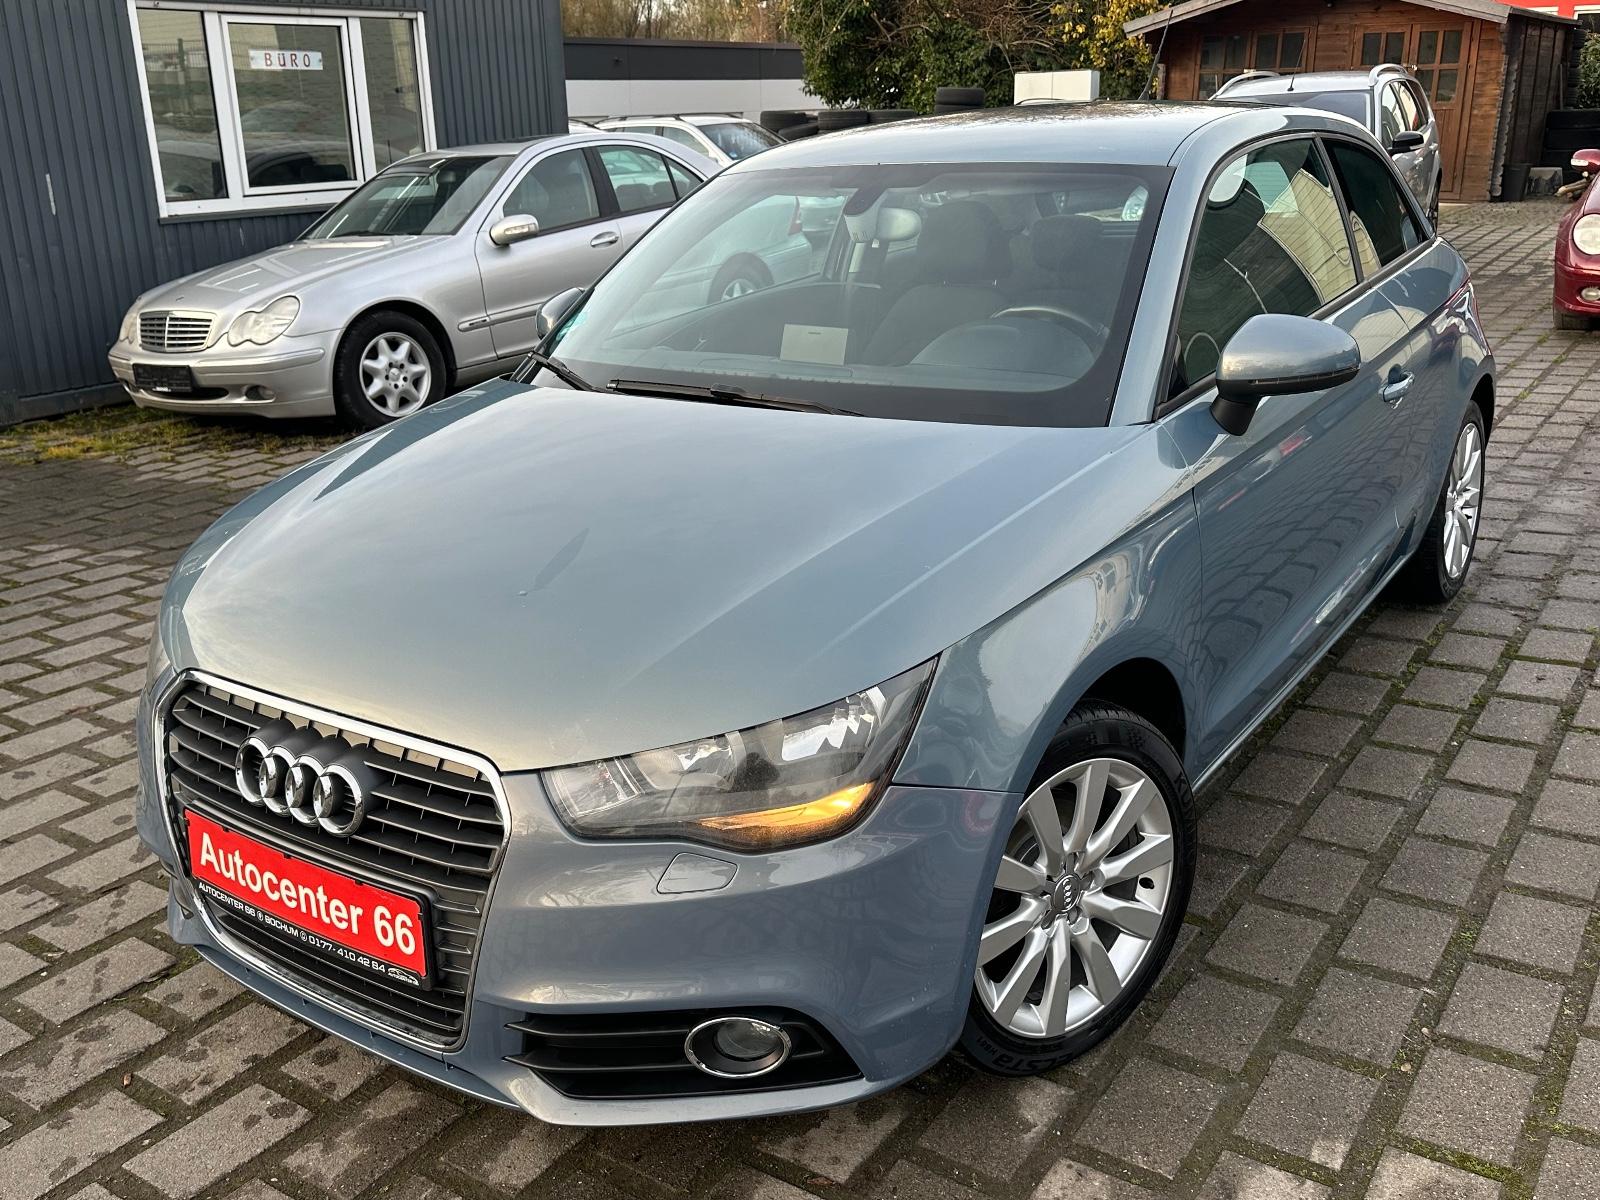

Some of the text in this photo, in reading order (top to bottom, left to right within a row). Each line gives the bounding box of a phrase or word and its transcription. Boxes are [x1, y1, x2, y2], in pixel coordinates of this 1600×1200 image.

[264, 52, 311, 67] BÜRO
[199, 882, 244, 911] AUTOCENTER
[244, 905, 256, 917] 66
[264, 915, 299, 937] BOCHUM
[337, 948, 356, 962] 410
[357, 956, 371, 968] 42
[371, 961, 386, 973] 84
[200, 832, 416, 956] Autocenter 66
